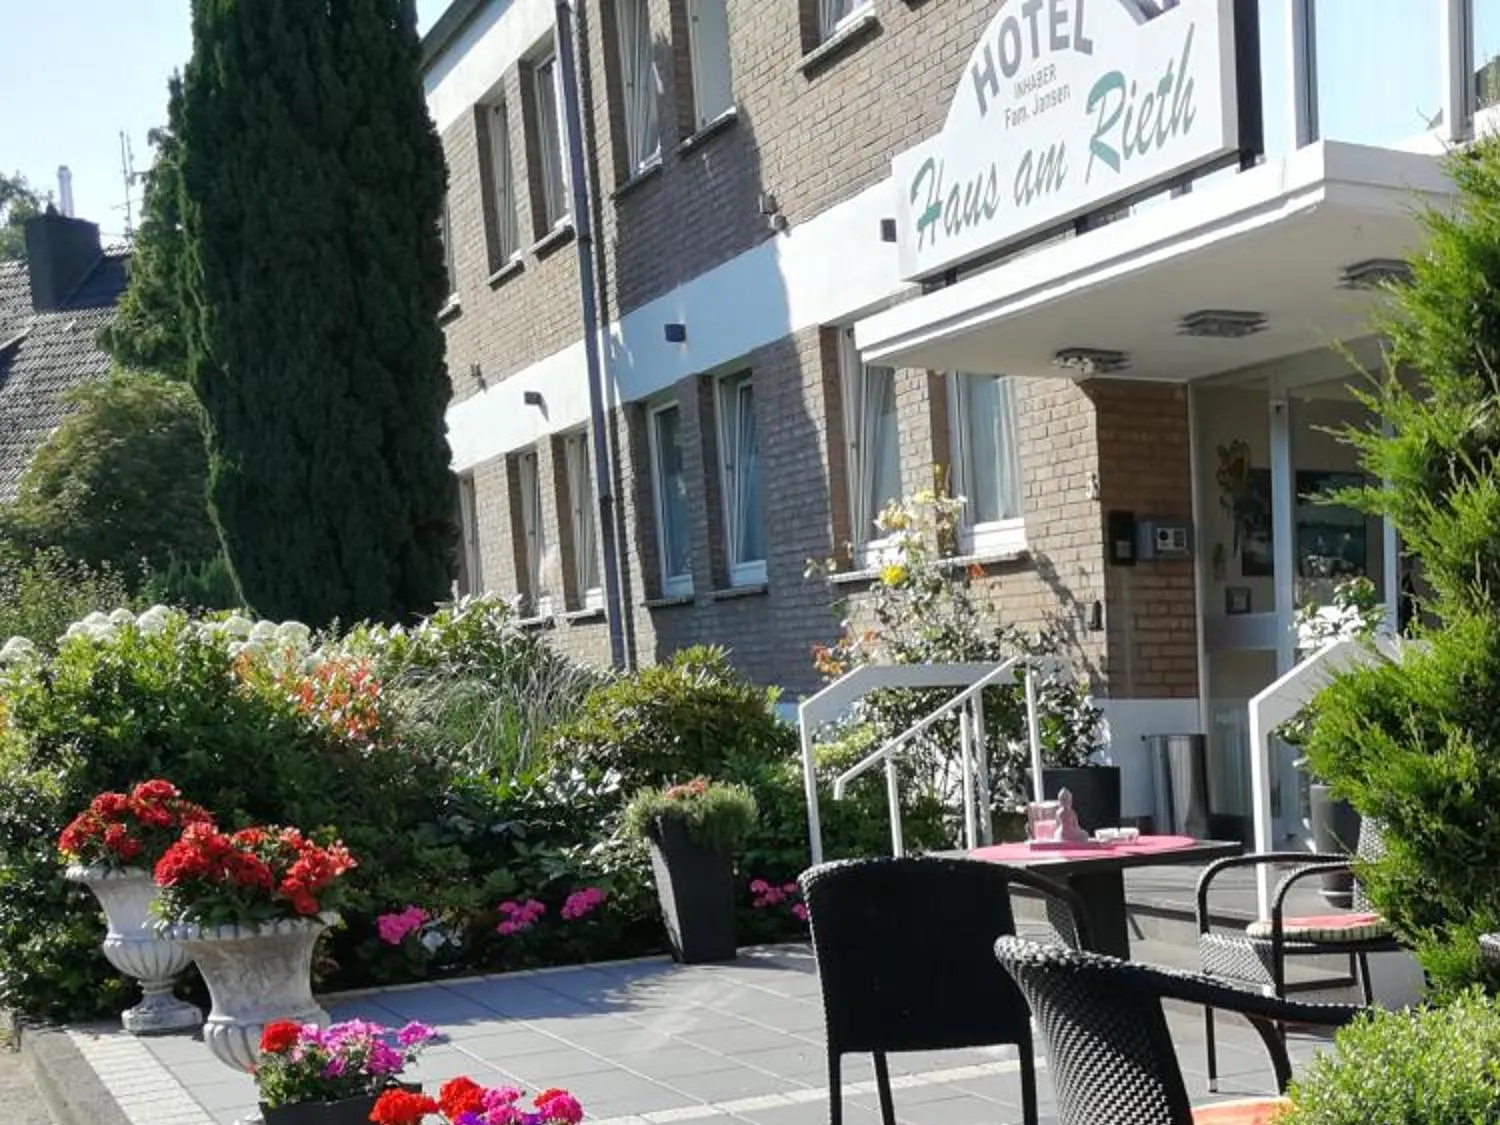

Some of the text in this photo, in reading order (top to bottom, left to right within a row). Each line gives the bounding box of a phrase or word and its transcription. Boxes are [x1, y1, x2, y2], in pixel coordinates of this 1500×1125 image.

[972, 0, 1093, 118] HOTEL
[1014, 63, 1057, 98] INHABER
[910, 22, 1196, 250] Haus am Rieth
[1032, 84, 1071, 116] Jansen
